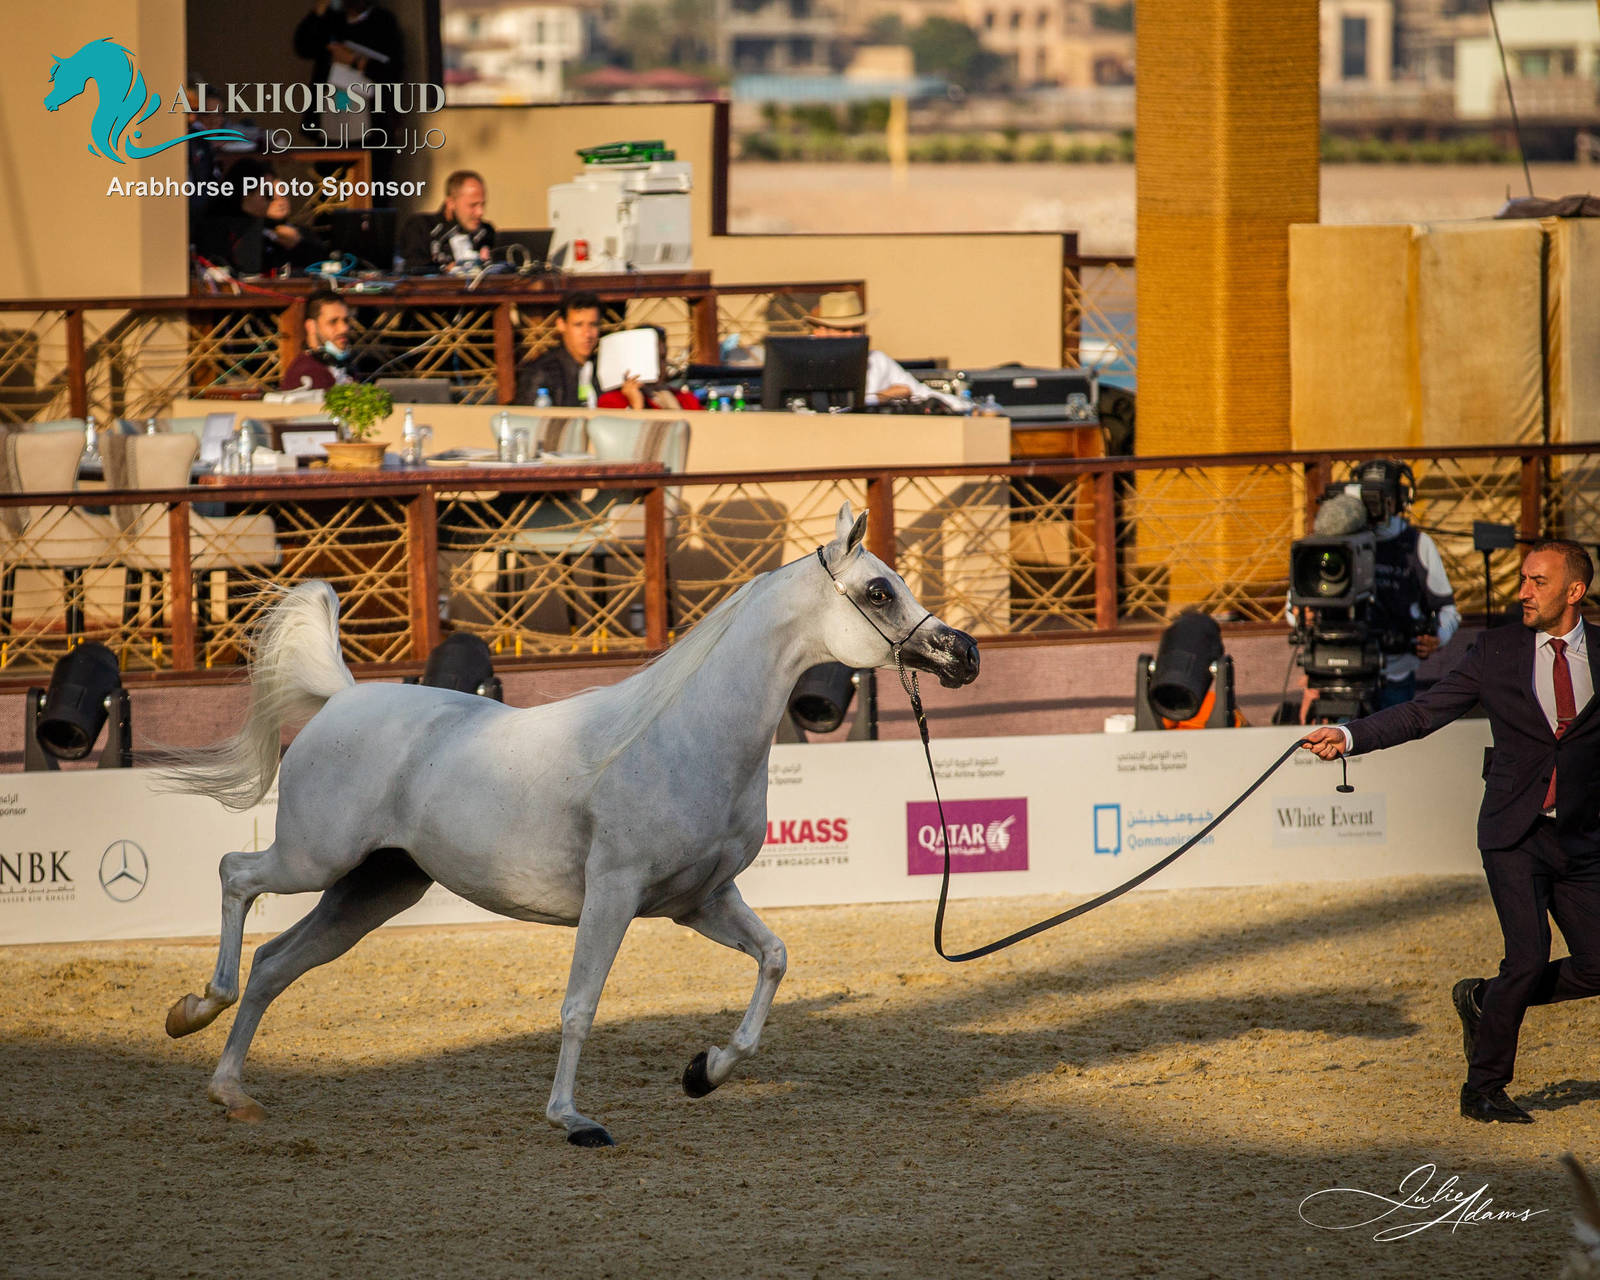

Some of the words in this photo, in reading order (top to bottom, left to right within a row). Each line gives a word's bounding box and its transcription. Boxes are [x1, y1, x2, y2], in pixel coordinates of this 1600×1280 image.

[0, 807, 27, 817] ponsor
[1276, 806, 1326, 828] White
[1331, 804, 1374, 827] Event
[764, 816, 849, 845] LKASS
[918, 823, 985, 851] QATAR
[0, 850, 73, 885] NBK
